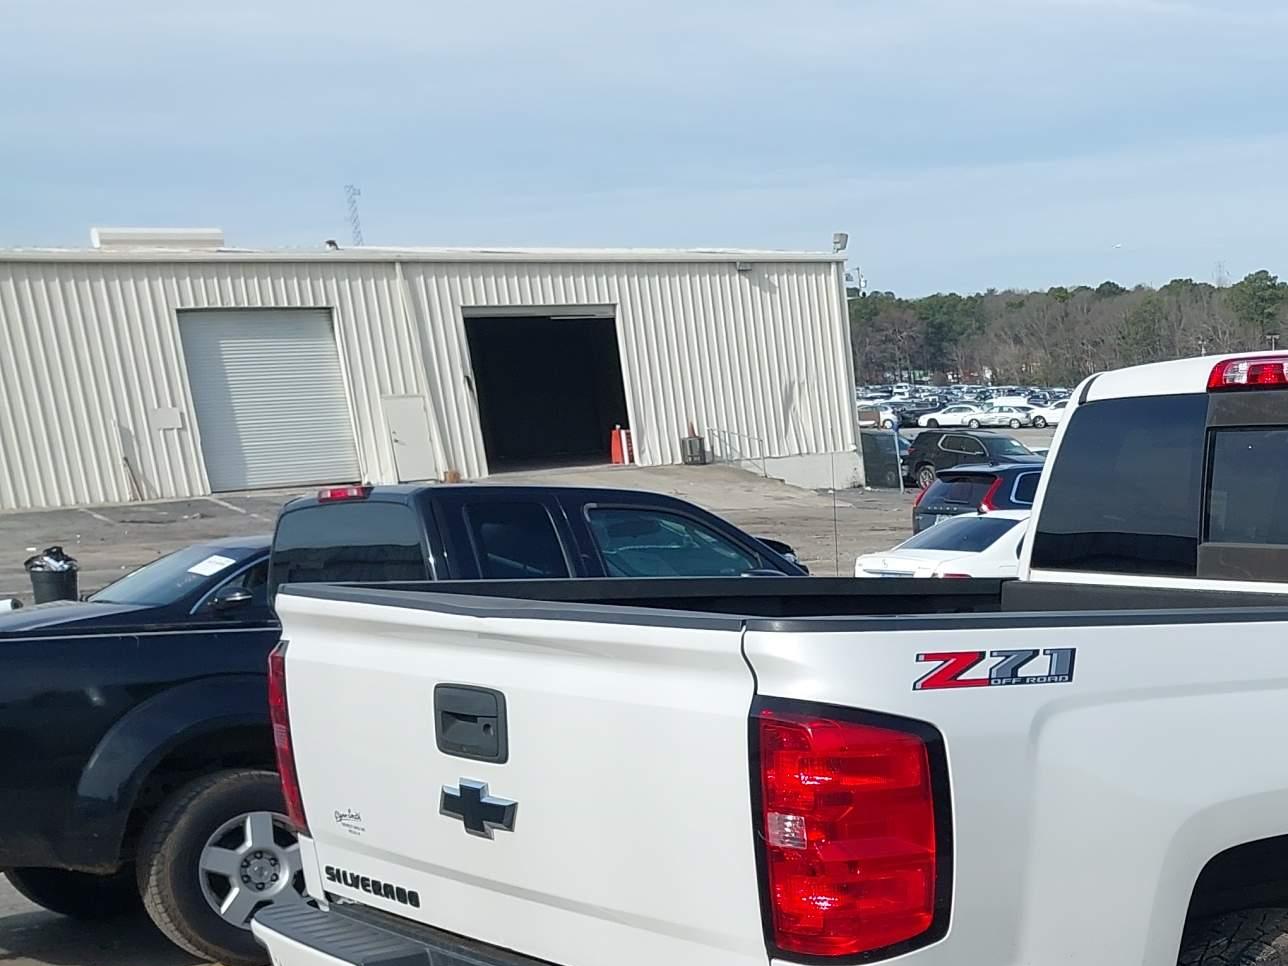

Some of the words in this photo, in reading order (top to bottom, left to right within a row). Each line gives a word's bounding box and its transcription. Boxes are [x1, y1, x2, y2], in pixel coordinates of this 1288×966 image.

[912, 648, 1077, 691] Z71
[991, 678, 1021, 686] OFF
[1025, 676, 1068, 684] ROAD
[325, 866, 420, 908] SILVERADO
